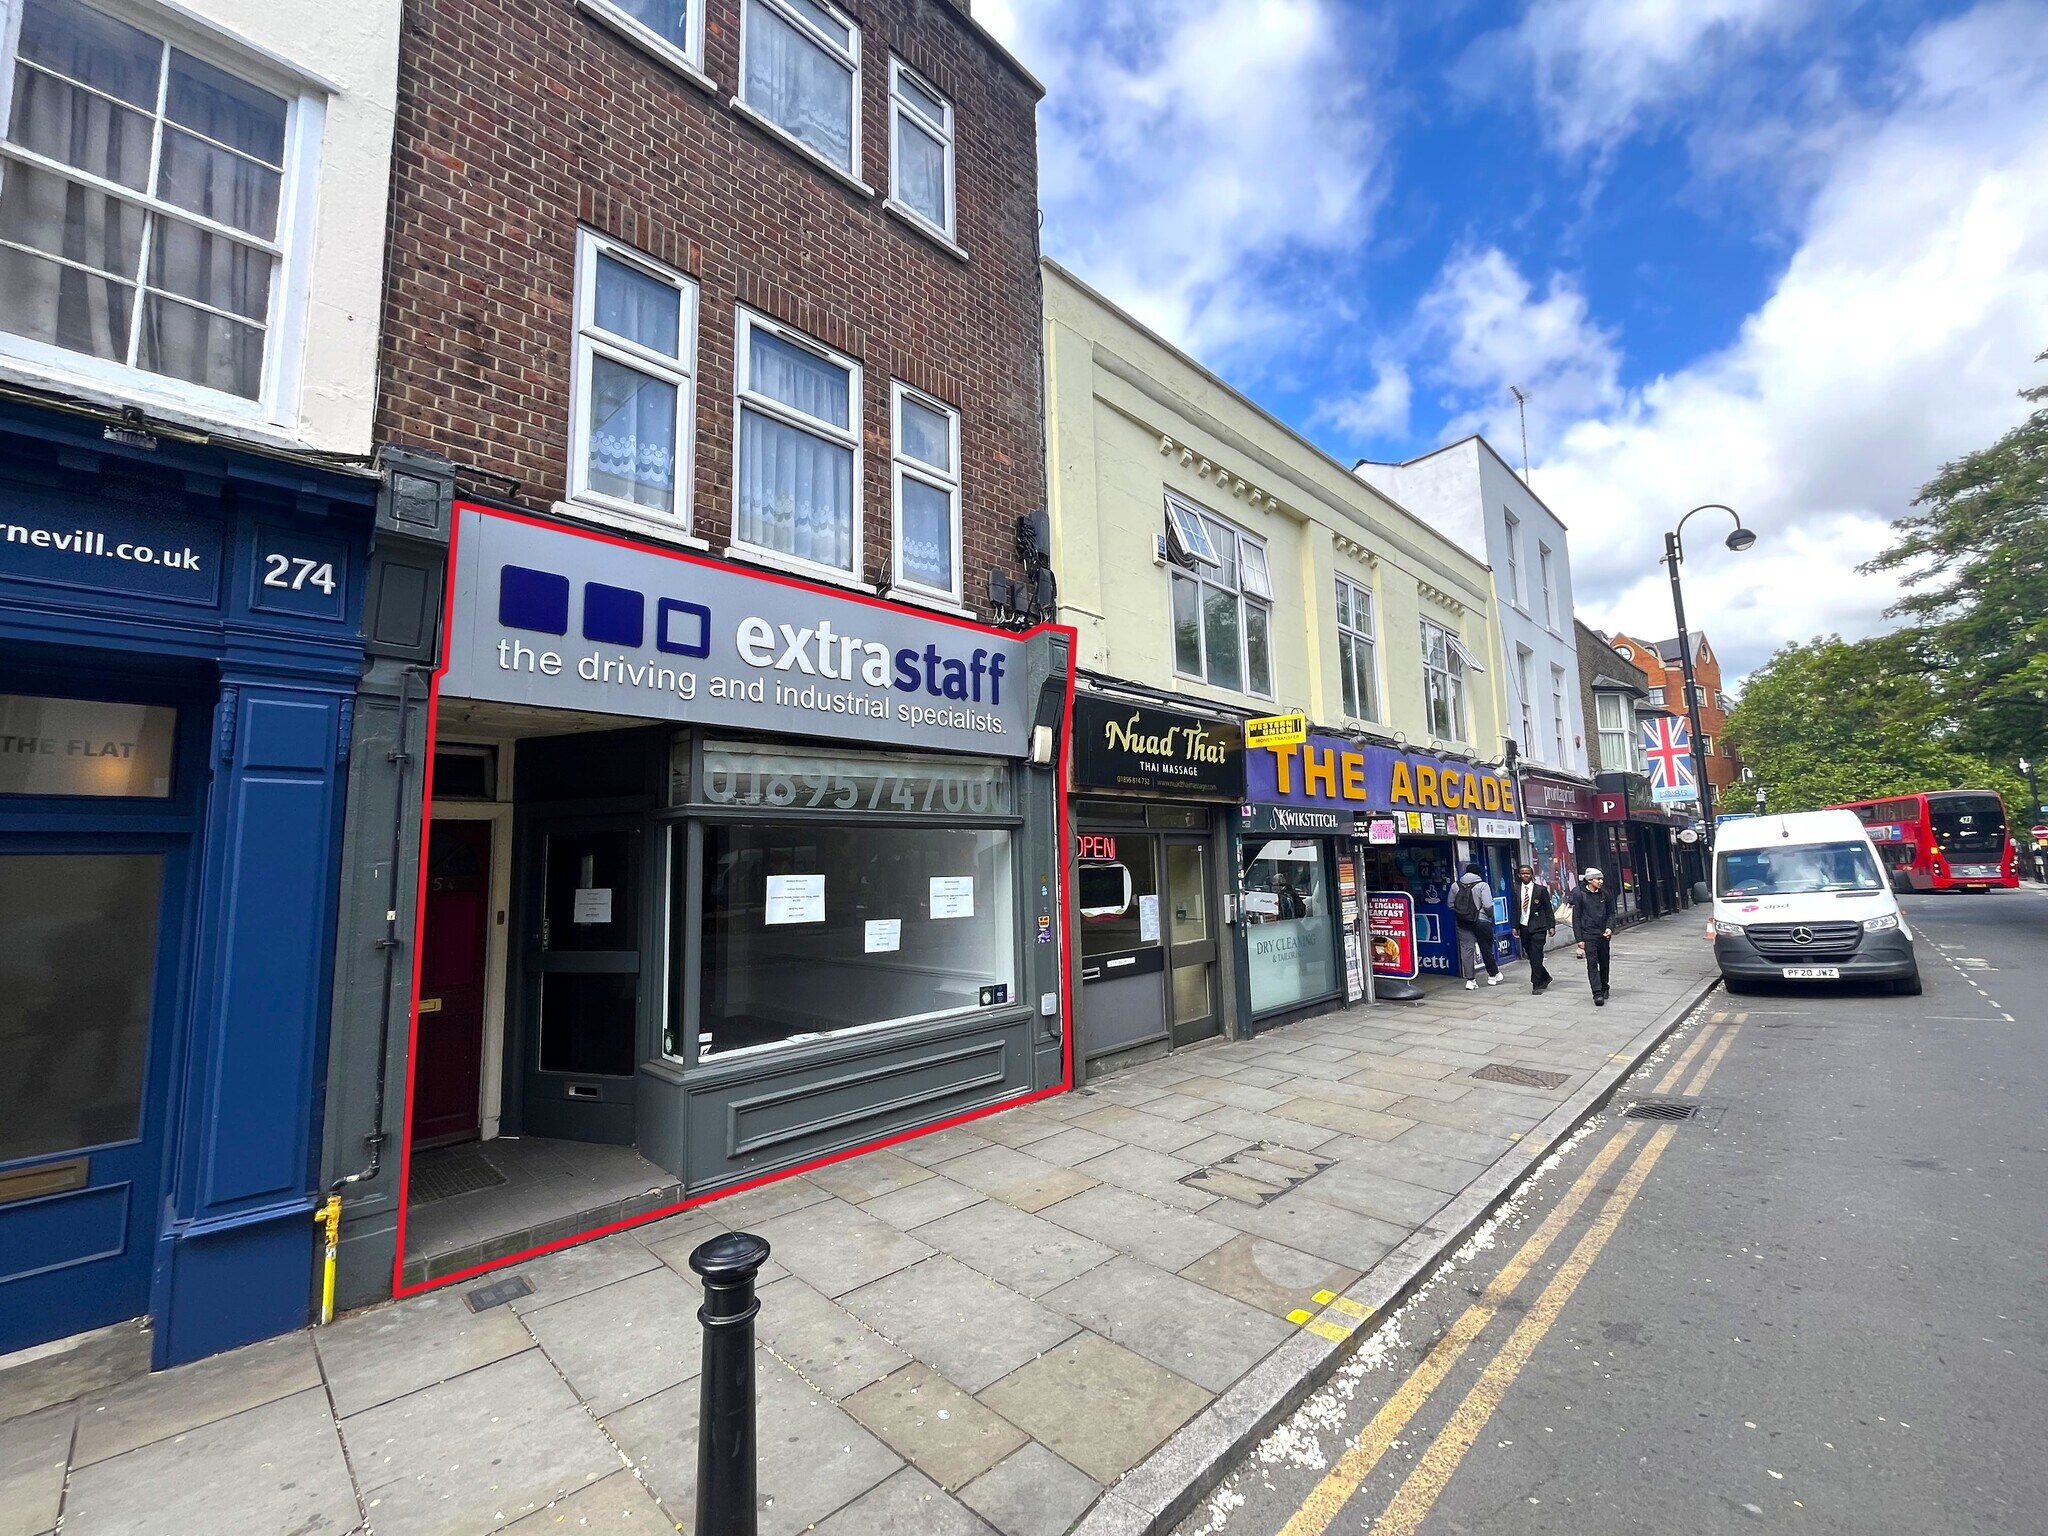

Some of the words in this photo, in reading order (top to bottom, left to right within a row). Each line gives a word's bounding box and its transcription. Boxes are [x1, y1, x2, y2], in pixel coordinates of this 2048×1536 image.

[264, 554, 336, 595] 274
[736, 616, 1006, 705] extrastaff
[497, 639, 562, 676] the
[578, 651, 697, 700] driving
[709, 675, 764, 703] and
[776, 678, 890, 719] industrial
[897, 702, 1008, 735] specialists.
[1249, 720, 1293, 731] WESTERN
[1262, 726, 1293, 736] UNION
[0, 735, 56, 754] THE
[67, 739, 135, 759] FLAT
[1105, 711, 1180, 757] Nuad
[1182, 719, 1226, 764] Thai
[1255, 736, 1273, 744] MONEY
[1274, 734, 1300, 742] TRANSFER
[1140, 761, 1160, 773] THAI
[1162, 763, 1198, 777] MASSAGE
[1267, 745, 1367, 800] THE
[1390, 761, 1515, 813] ARCADE
[1389, 929, 1406, 937] CAFE
[1256, 939, 1275, 955] DRY
[1275, 934, 1317, 952] CLEANING
[1787, 968, 1813, 977] PF20
[1815, 969, 1836, 977] JWZ
